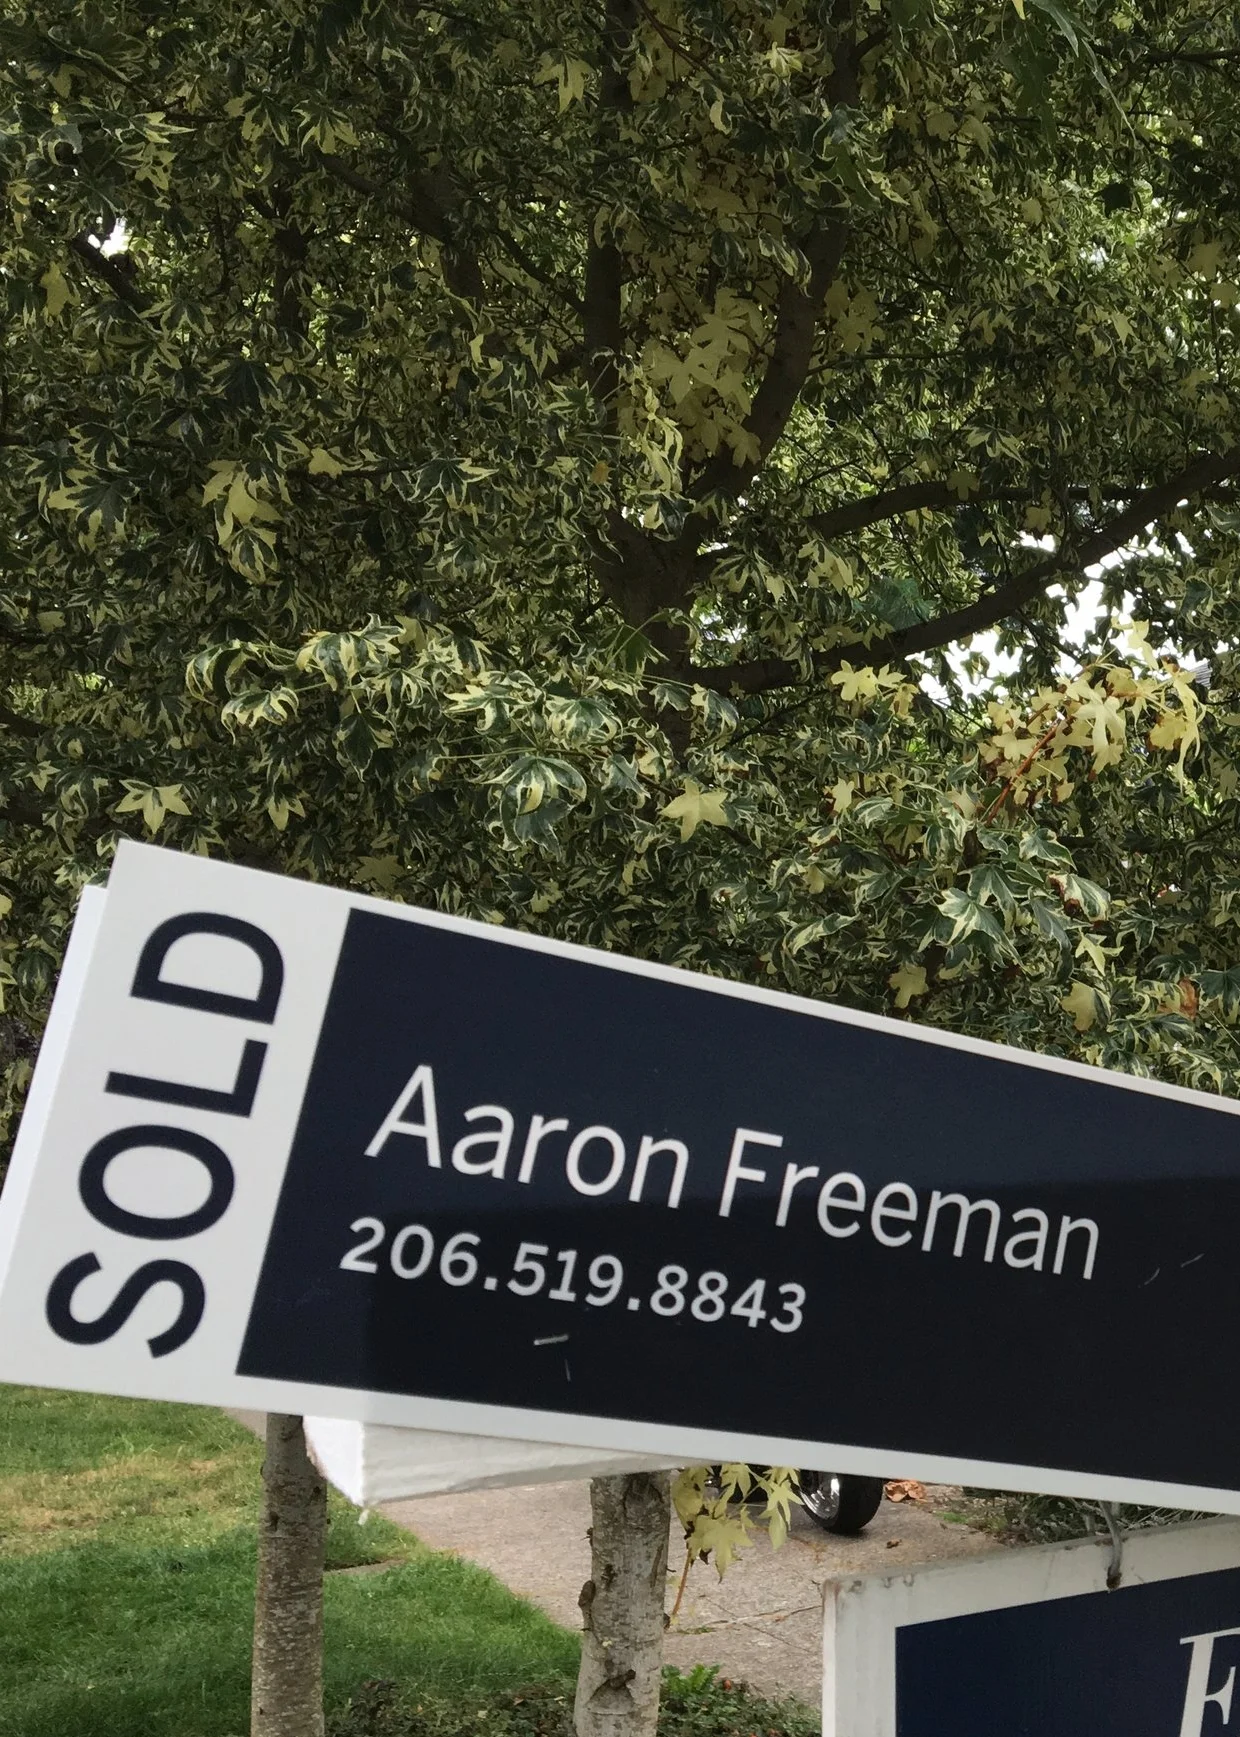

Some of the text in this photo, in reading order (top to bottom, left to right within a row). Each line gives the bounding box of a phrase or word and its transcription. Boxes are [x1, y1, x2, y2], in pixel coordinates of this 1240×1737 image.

[45, 912, 285, 1359] SOLD
[364, 1064, 1099, 1280] Aaron Freeman
[339, 1216, 806, 1333] 206.519.8843
